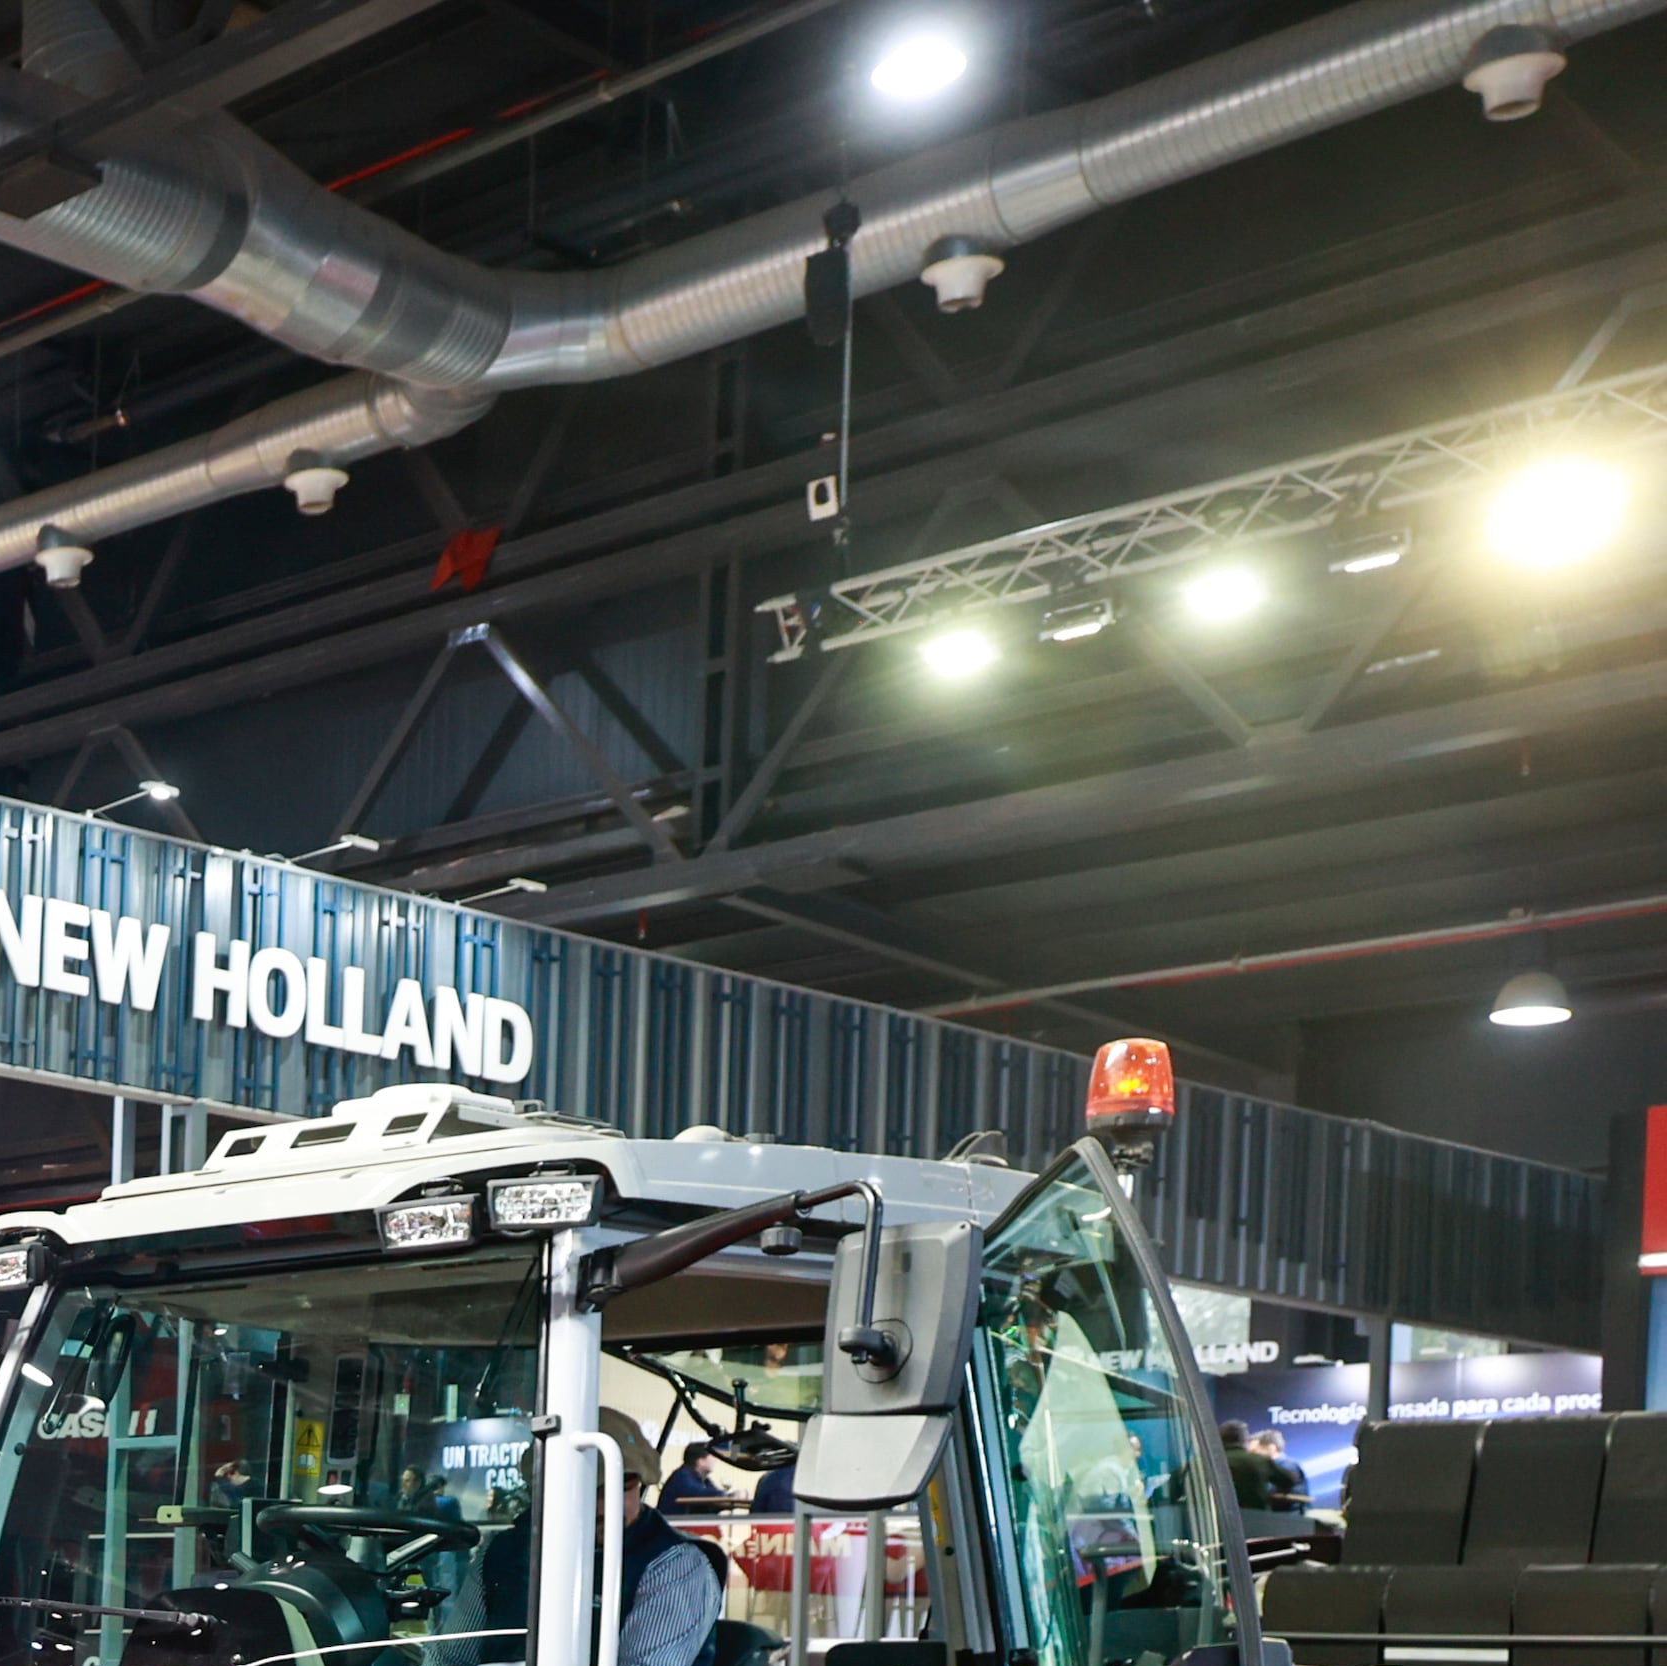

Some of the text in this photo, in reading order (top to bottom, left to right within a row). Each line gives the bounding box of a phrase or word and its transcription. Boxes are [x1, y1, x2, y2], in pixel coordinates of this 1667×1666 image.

[192, 930, 533, 1083] HOLLAND
[1145, 1341, 1279, 1371] HLLAND
[1269, 1402, 1366, 1424] Tecnología
[1388, 1397, 1449, 1419] nsada
[1452, 1397, 1499, 1417] para
[1501, 1392, 1550, 1412] cada
[36, 1410, 109, 1440] CAS
[442, 1446, 466, 1469] UN
[486, 1467, 525, 1490] CAD
